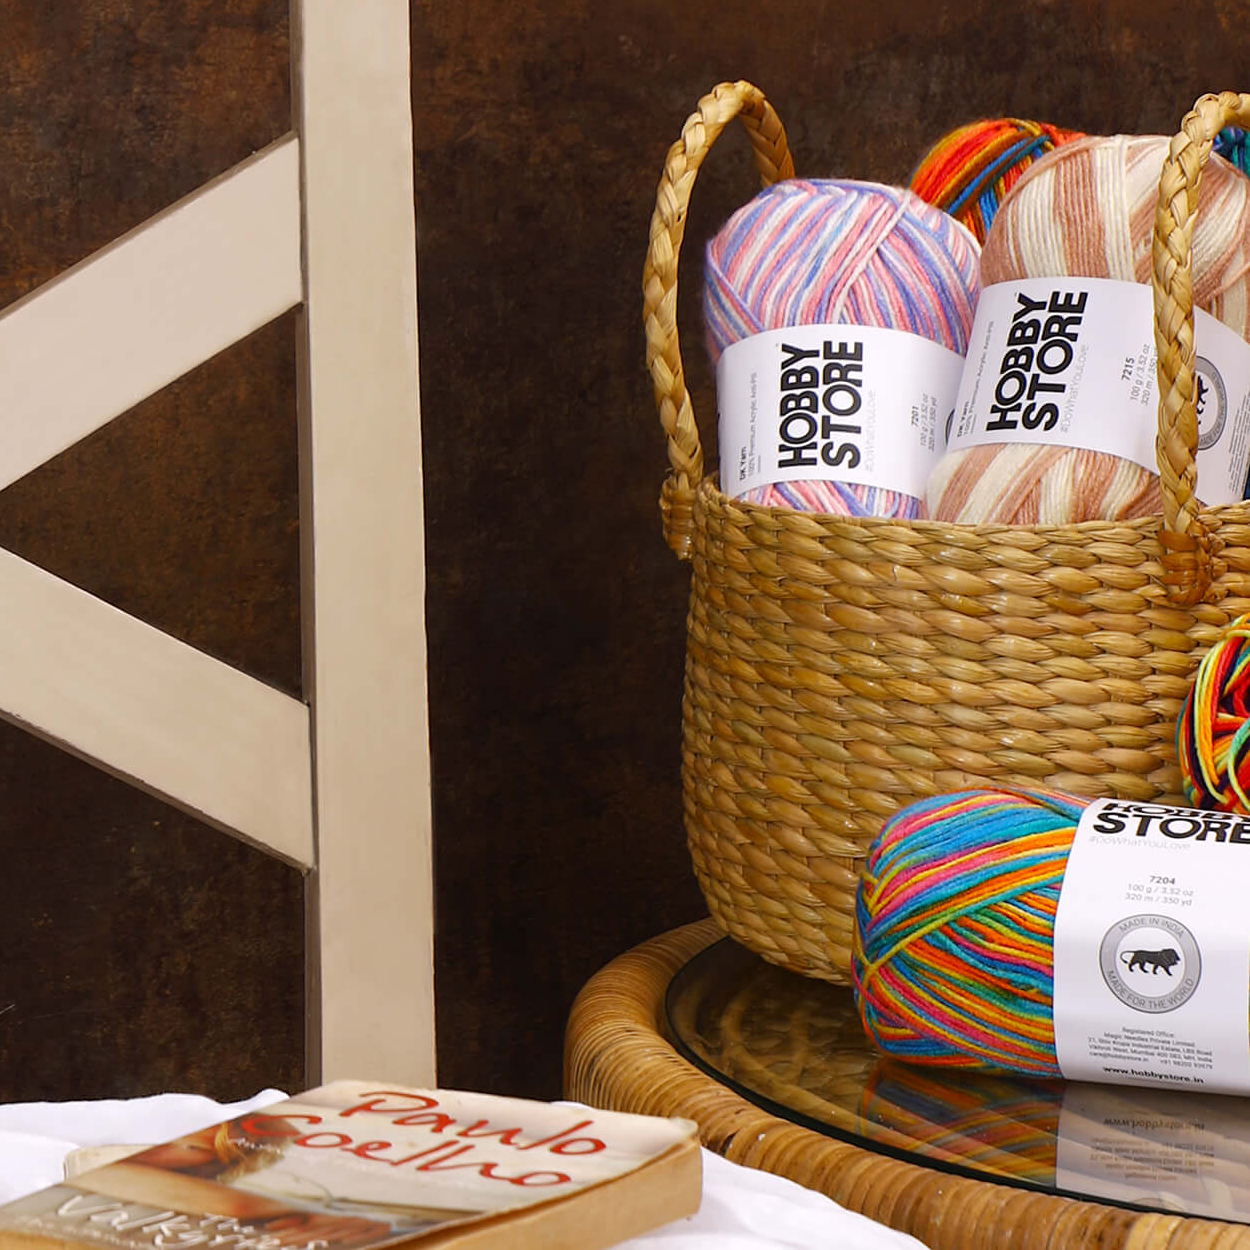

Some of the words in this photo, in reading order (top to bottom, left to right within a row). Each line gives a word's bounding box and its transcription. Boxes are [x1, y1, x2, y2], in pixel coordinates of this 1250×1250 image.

[986, 292, 1047, 432] HOBBY
[1021, 291, 1088, 432] STORE
[1121, 357, 1135, 381] 7215
[777, 343, 820, 469] HOBBY
[821, 341, 864, 469] STORE
[1149, 875, 1176, 884] 7204
[1119, 917, 1148, 932] MADE
[1149, 917, 1160, 926] IN
[1161, 919, 1185, 938] INDIA
[1107, 970, 1127, 998] MADE
[1126, 995, 1146, 1007] FOR
[1149, 999, 1166, 1009] THE
[1167, 978, 1194, 1006] WORLD
[1102, 1066, 1204, 1084] www.hobbystore.in
[241, 1114, 572, 1187] Coelho
[340, 1091, 607, 1155] Paulo
